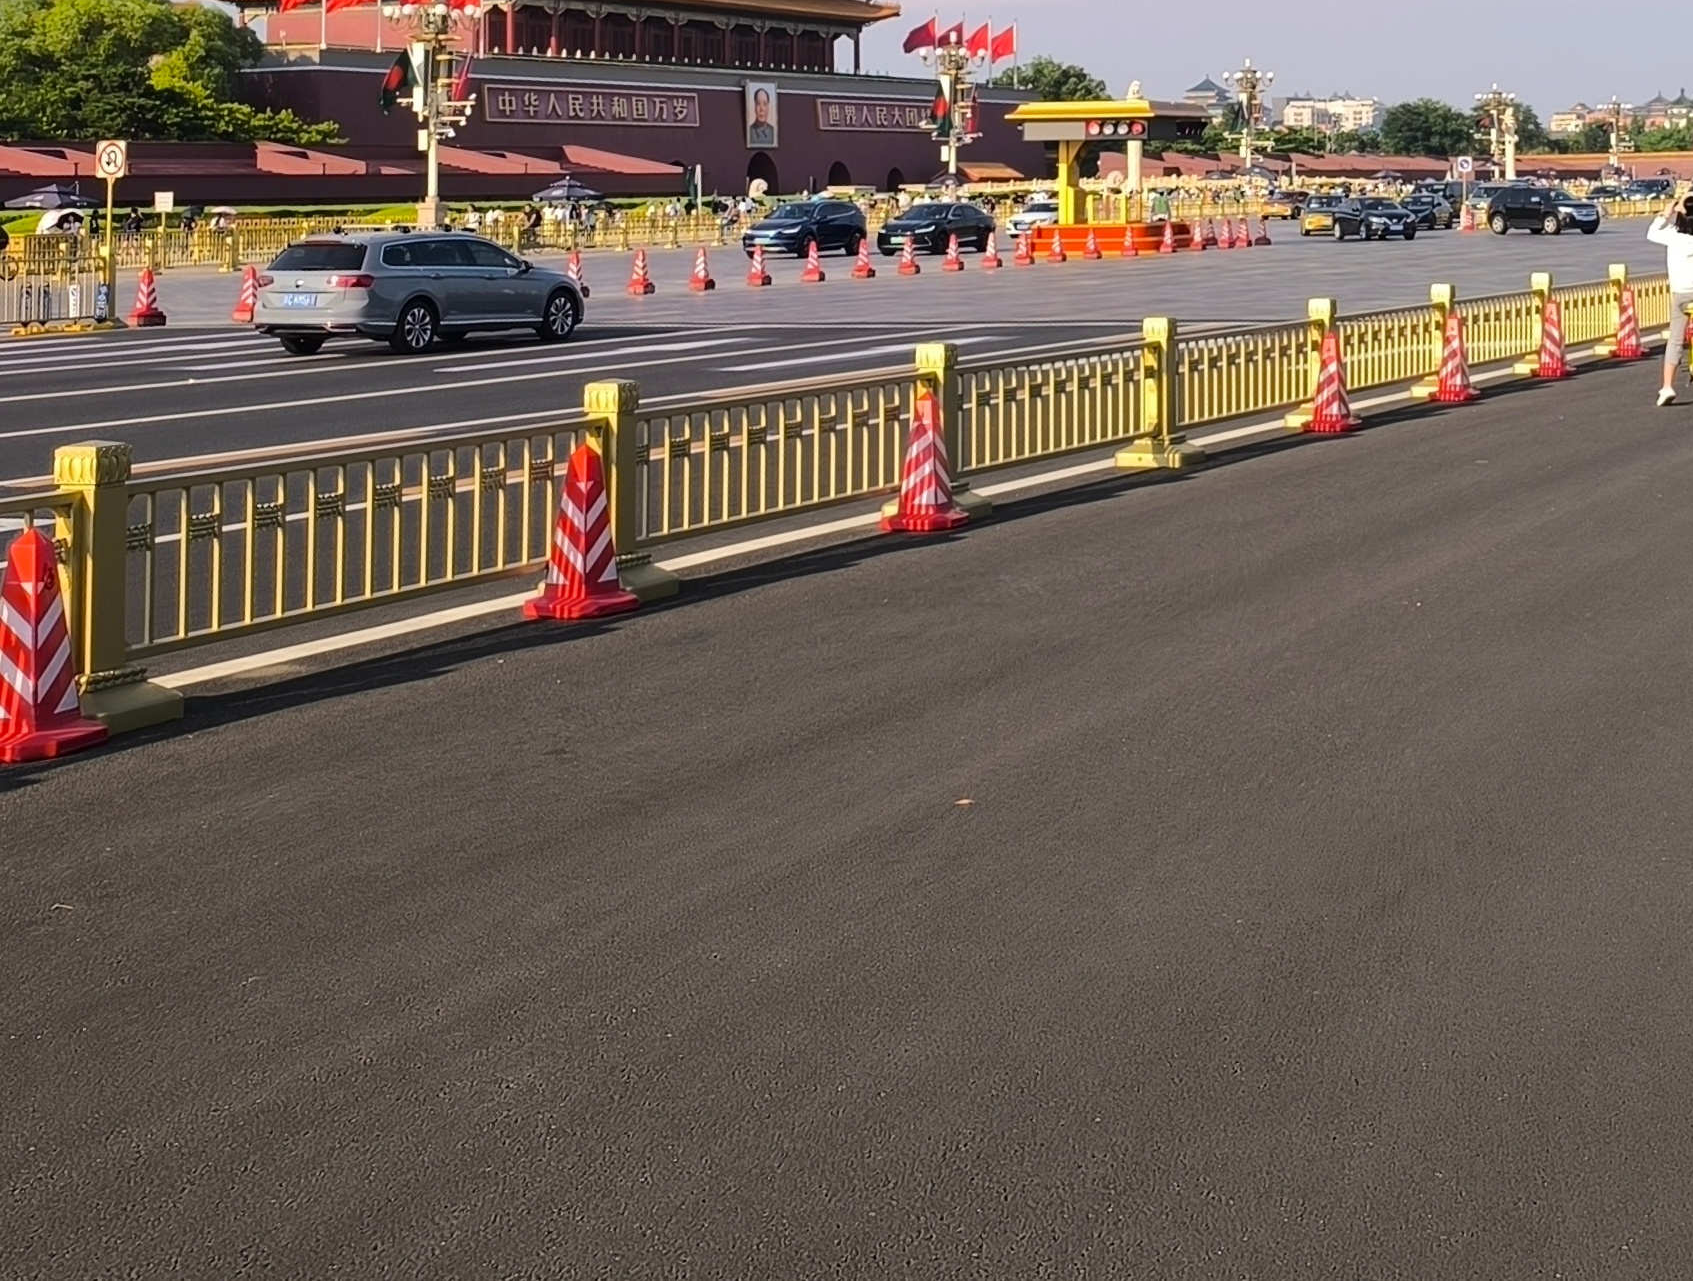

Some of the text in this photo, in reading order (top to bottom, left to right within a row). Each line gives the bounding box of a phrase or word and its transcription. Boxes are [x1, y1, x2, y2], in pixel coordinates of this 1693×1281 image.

[498, 90, 688, 120] 中华人民共和国万岁
